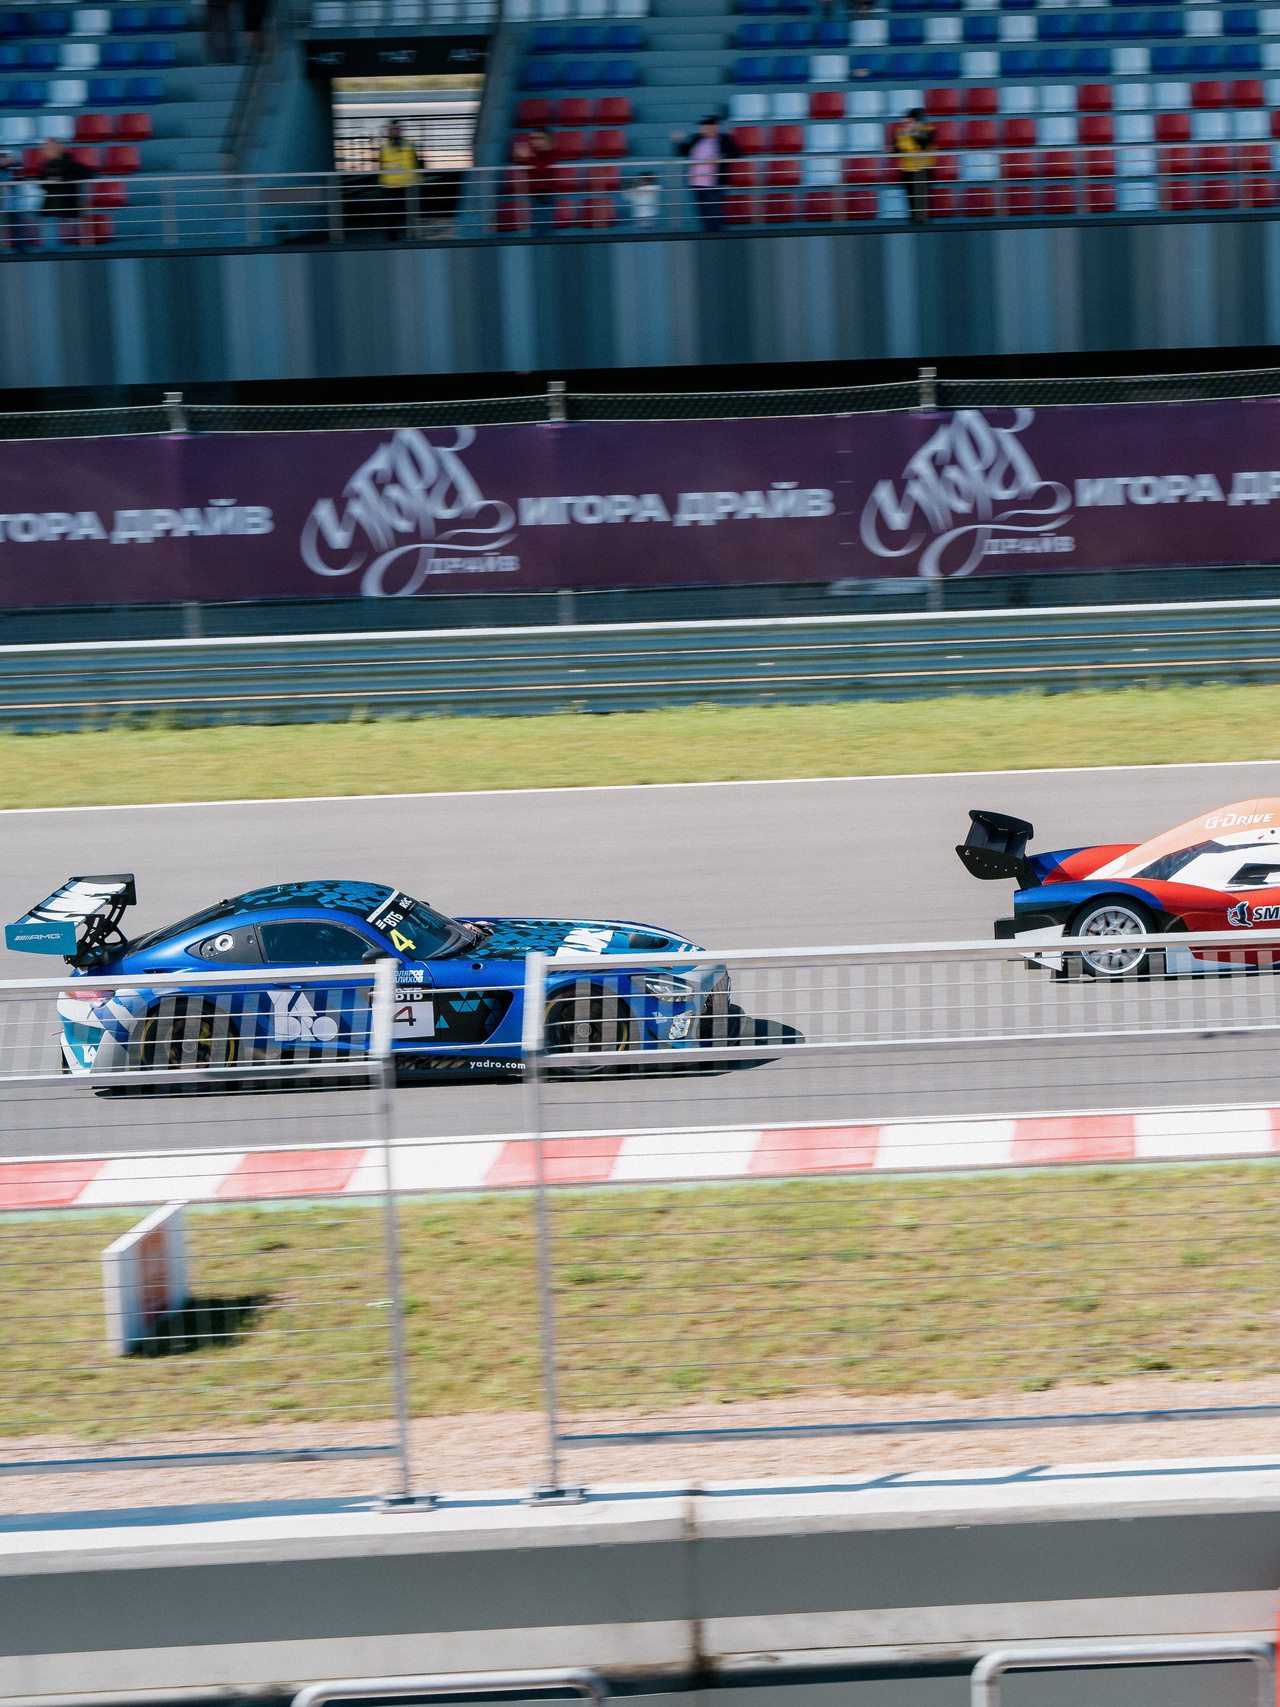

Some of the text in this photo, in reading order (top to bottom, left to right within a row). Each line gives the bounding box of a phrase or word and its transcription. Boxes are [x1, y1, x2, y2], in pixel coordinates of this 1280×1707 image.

[1075, 474, 1226, 506] ИГОРА
[518, 482, 836, 526] ИГОРА ДРАЙВ
[109, 499, 275, 544] ДРАЙВ
[981, 532, 1075, 554] ДРАЙВ
[424, 552, 520, 574] ДРАЙВ
[383, 911, 403, 927] ВТБ
[390, 929, 416, 952] 4
[391, 1005, 417, 1027] 4
[470, 1060, 526, 1069] yadro.com
